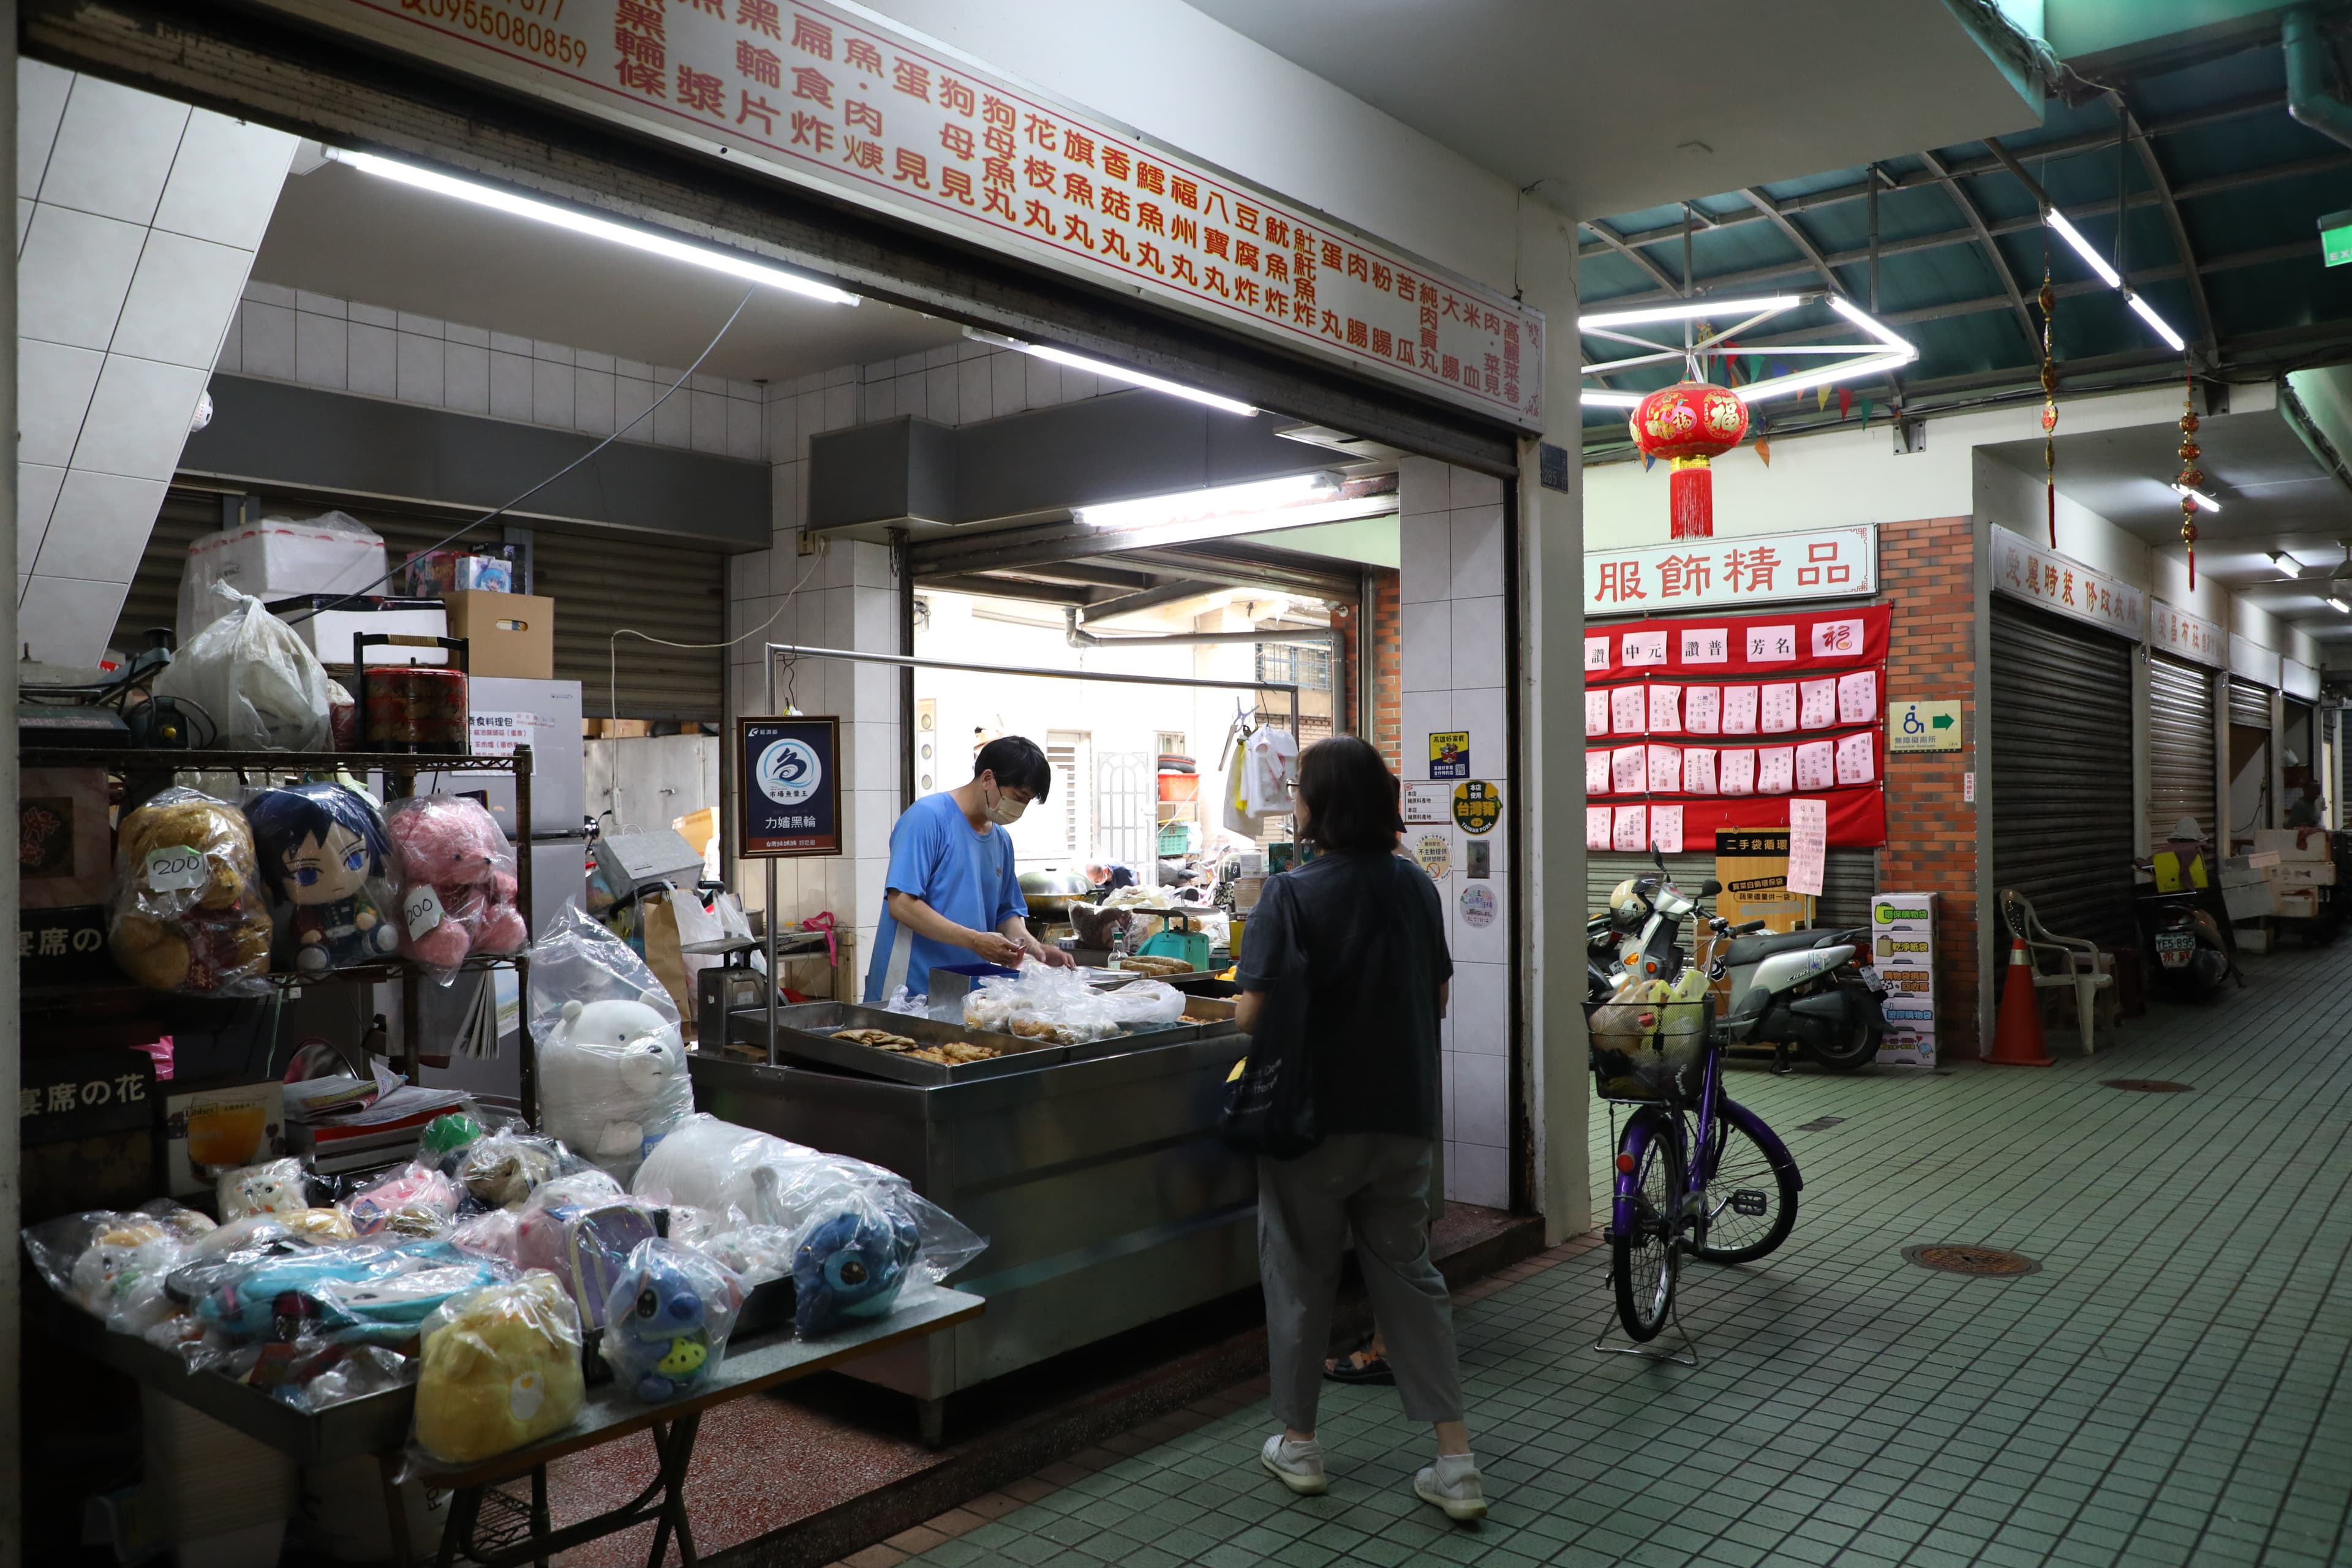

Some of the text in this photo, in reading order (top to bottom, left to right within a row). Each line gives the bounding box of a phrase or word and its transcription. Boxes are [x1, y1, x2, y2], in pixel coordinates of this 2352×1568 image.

[430, 0, 587, 67] 0955080859
[736, 0, 781, 135] 黑輪片
[791, 12, 835, 154] 扁食炸
[892, 56, 932, 191] 蛋見
[938, 75, 975, 206] 狗母見
[981, 93, 1017, 222] 狗母魚丸
[1023, 113, 1057, 236] 花枝丸
[1063, 129, 1095, 250] 旗魚丸
[1101, 145, 1131, 263] 香菇丸
[1136, 160, 1165, 275] 鱈魚丸
[1170, 175, 1198, 287] 福州丸
[1203, 190, 1230, 298] 八寶丸
[1234, 202, 1260, 307] 豆腐炸
[1265, 216, 1289, 318] 魷魚炸
[1321, 239, 1343, 340] 蛋丸
[1348, 253, 1368, 349] 肉腸
[1372, 262, 1393, 358] 粉腸
[1396, 273, 1416, 367] 苦瓜
[1419, 282, 1438, 375] 純肉貢丸
[1441, 294, 1460, 383] 大腸
[1463, 303, 1480, 391] 米血
[1503, 319, 1520, 404] 高麗菜卷
[1711, 396, 1741, 431] 福
[1594, 541, 1850, 603] 服飾精品
[1626, 643, 1662, 660] 中元
[1685, 640, 1722, 657] 讚普
[1751, 638, 1790, 655] 芳名
[469, 717, 513, 727] 素食料理包
[765, 816, 816, 829] 力嬸黑輪
[1457, 801, 1495, 816] 台灣豬
[1461, 821, 1493, 833] TAIWAN PORK
[1727, 839, 1787, 850] 二手袋循環
[153, 857, 200, 875] 200
[406, 899, 433, 925] 200
[1885, 910, 1928, 919] 環保購物袋
[1892, 942, 1928, 952] 乾淨紙袋
